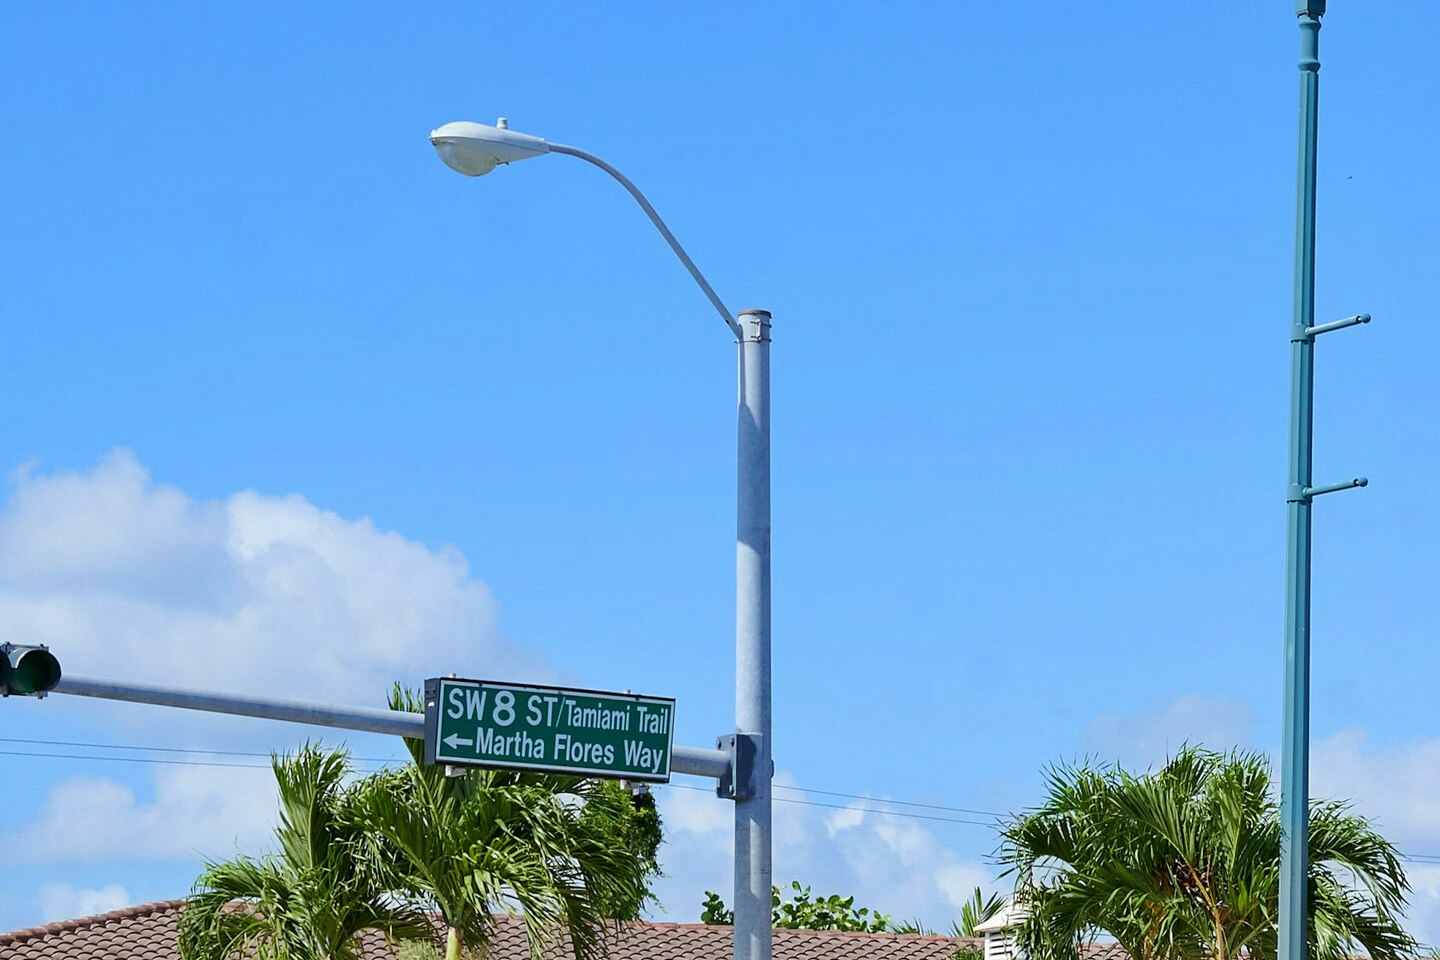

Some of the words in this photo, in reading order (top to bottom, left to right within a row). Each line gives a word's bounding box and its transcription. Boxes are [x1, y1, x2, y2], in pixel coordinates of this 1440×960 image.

[447, 688, 487, 721] SW
[492, 690, 516, 727] 8
[637, 706, 669, 735] Trail
[475, 726, 545, 759] Martha
[554, 733, 615, 765] Flores
[624, 739, 663, 774] Way
